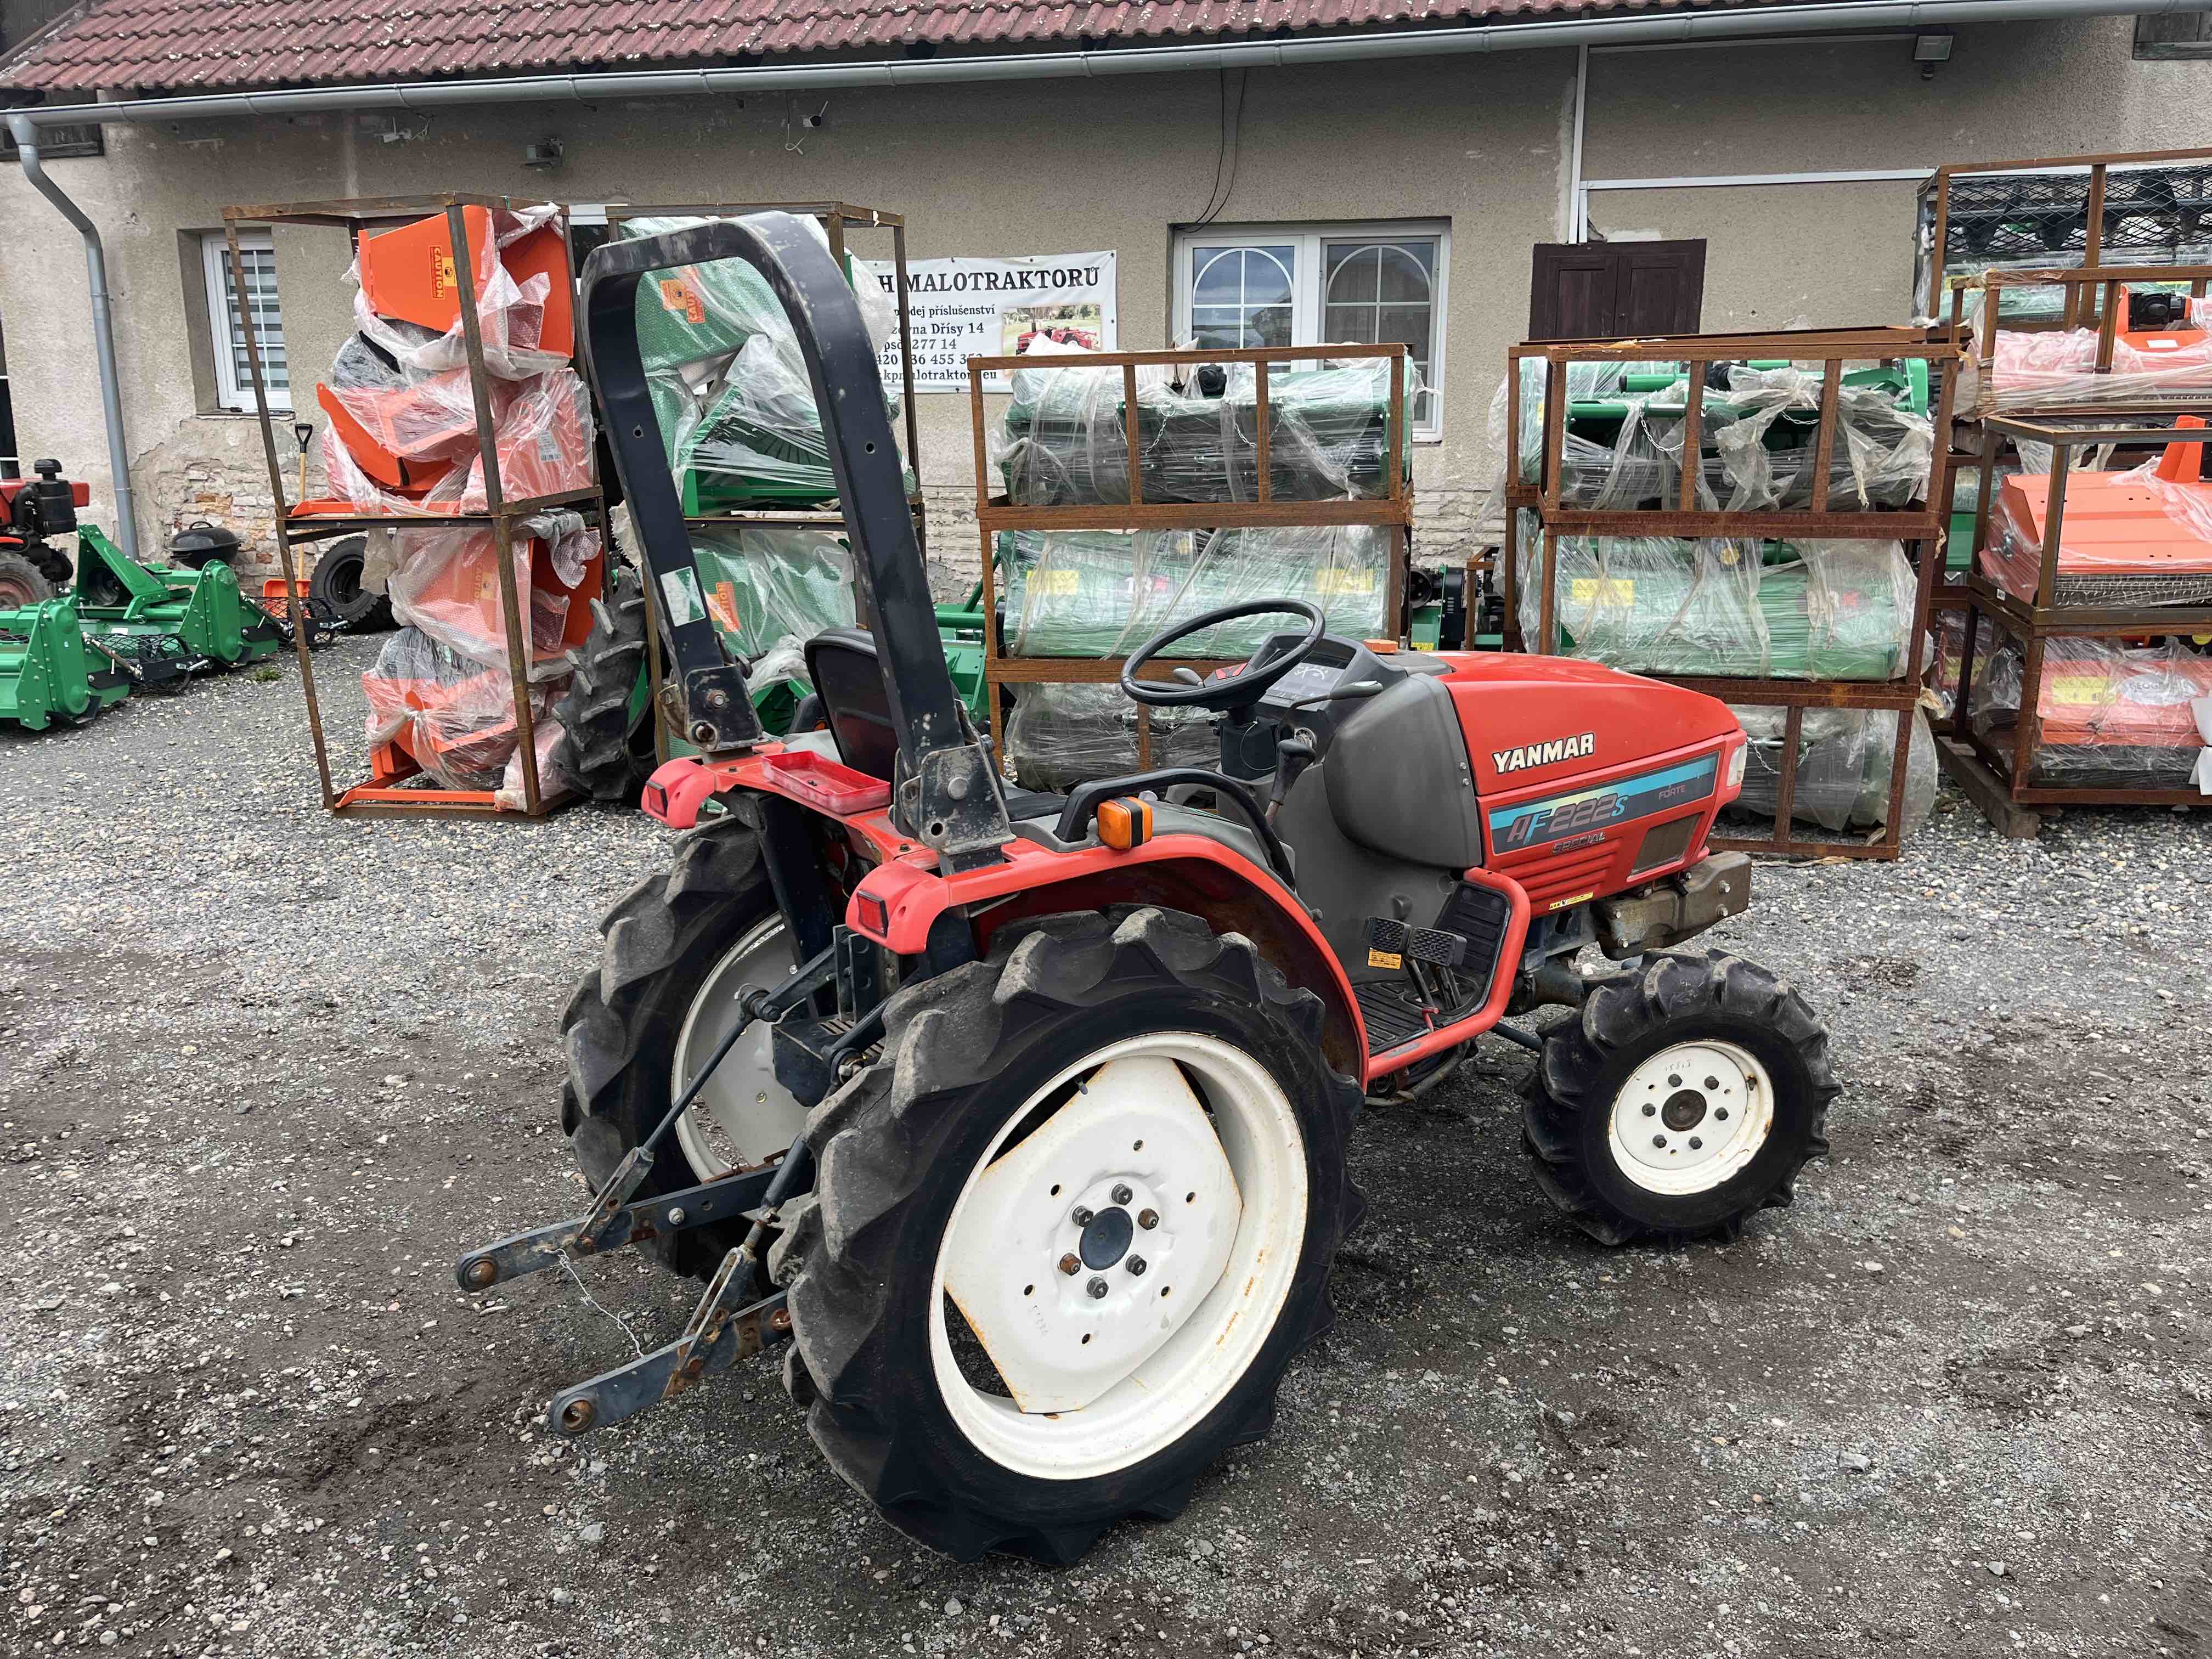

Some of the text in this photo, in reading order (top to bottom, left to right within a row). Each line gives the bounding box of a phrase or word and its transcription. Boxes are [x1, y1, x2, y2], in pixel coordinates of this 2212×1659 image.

[434, 247, 443, 298] CAUTION
[929, 303, 995, 318] příslušenství
[931, 322, 963, 336] Dřísy
[968, 322, 984, 333] 14
[912, 339, 936, 349] 277
[941, 338, 957, 349] 14
[930, 354, 954, 365] 455
[1493, 732, 1595, 774] YANMAR
